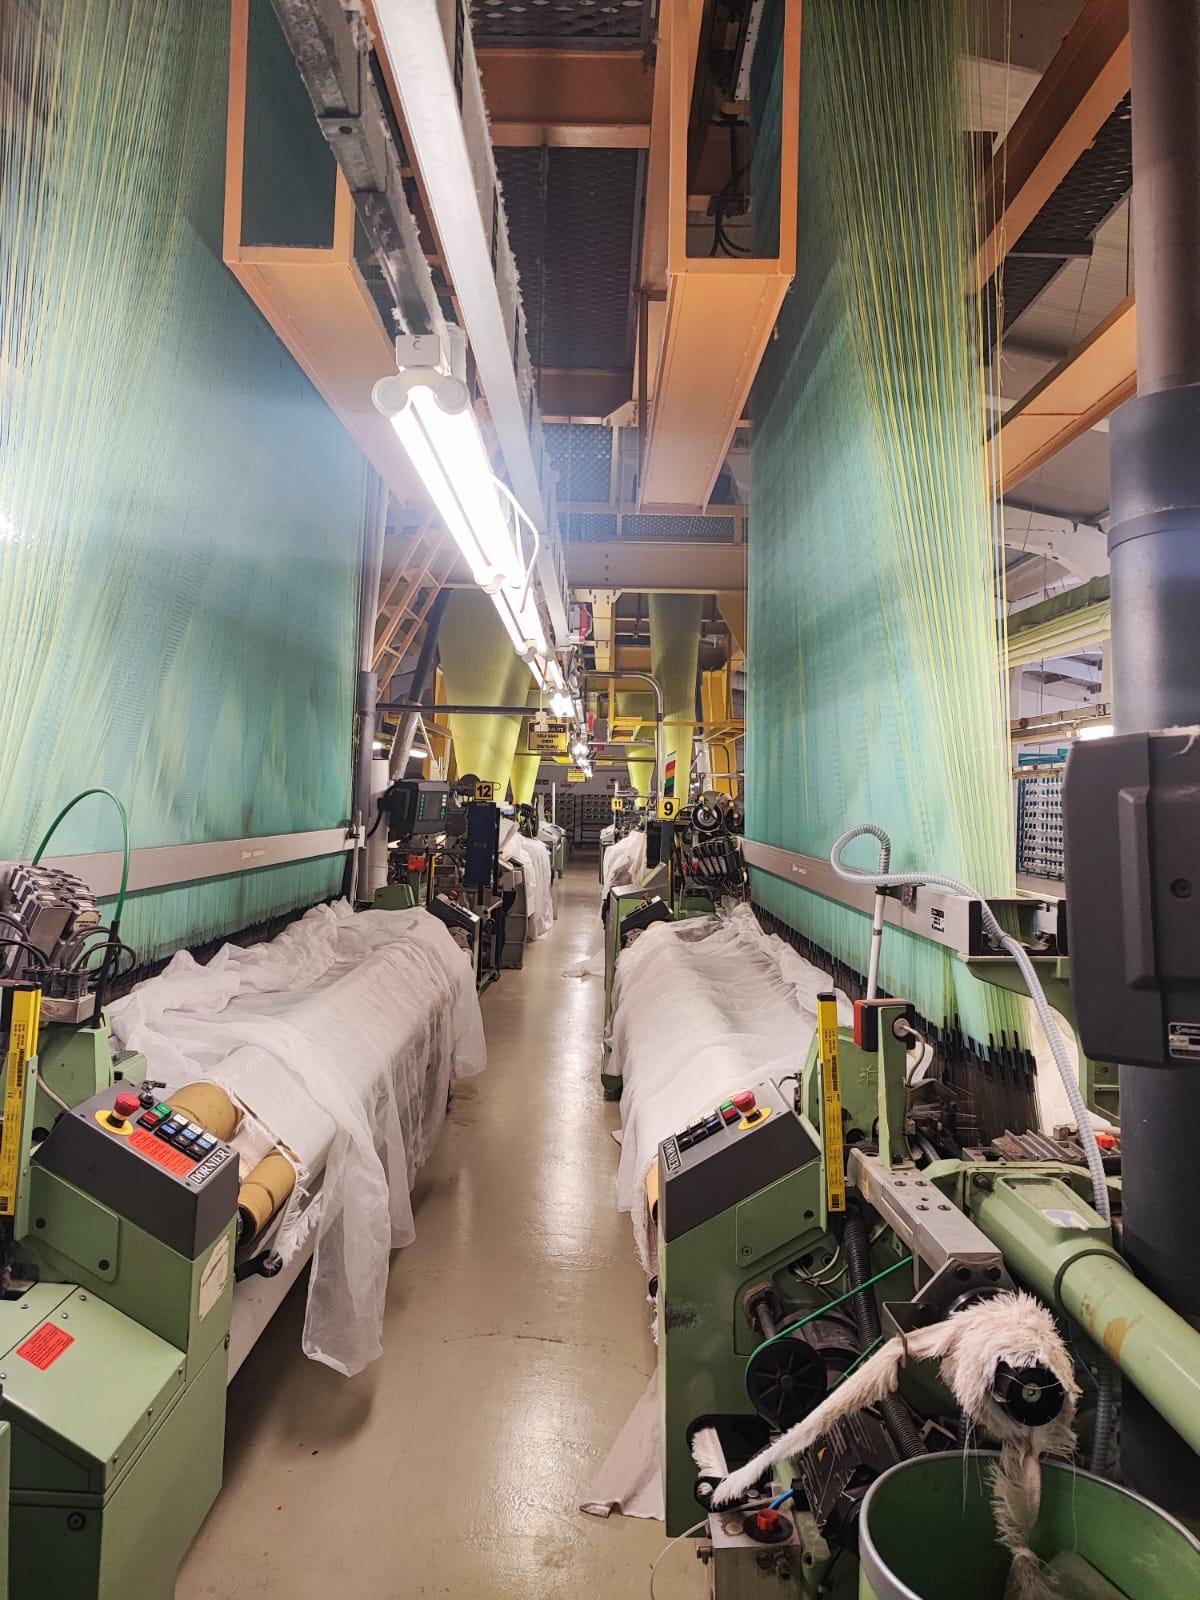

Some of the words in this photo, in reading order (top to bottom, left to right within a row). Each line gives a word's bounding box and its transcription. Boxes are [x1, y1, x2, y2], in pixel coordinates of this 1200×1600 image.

[476, 784, 492, 798] 12
[663, 801, 674, 817] 9
[189, 1149, 231, 1184] DORNIER
